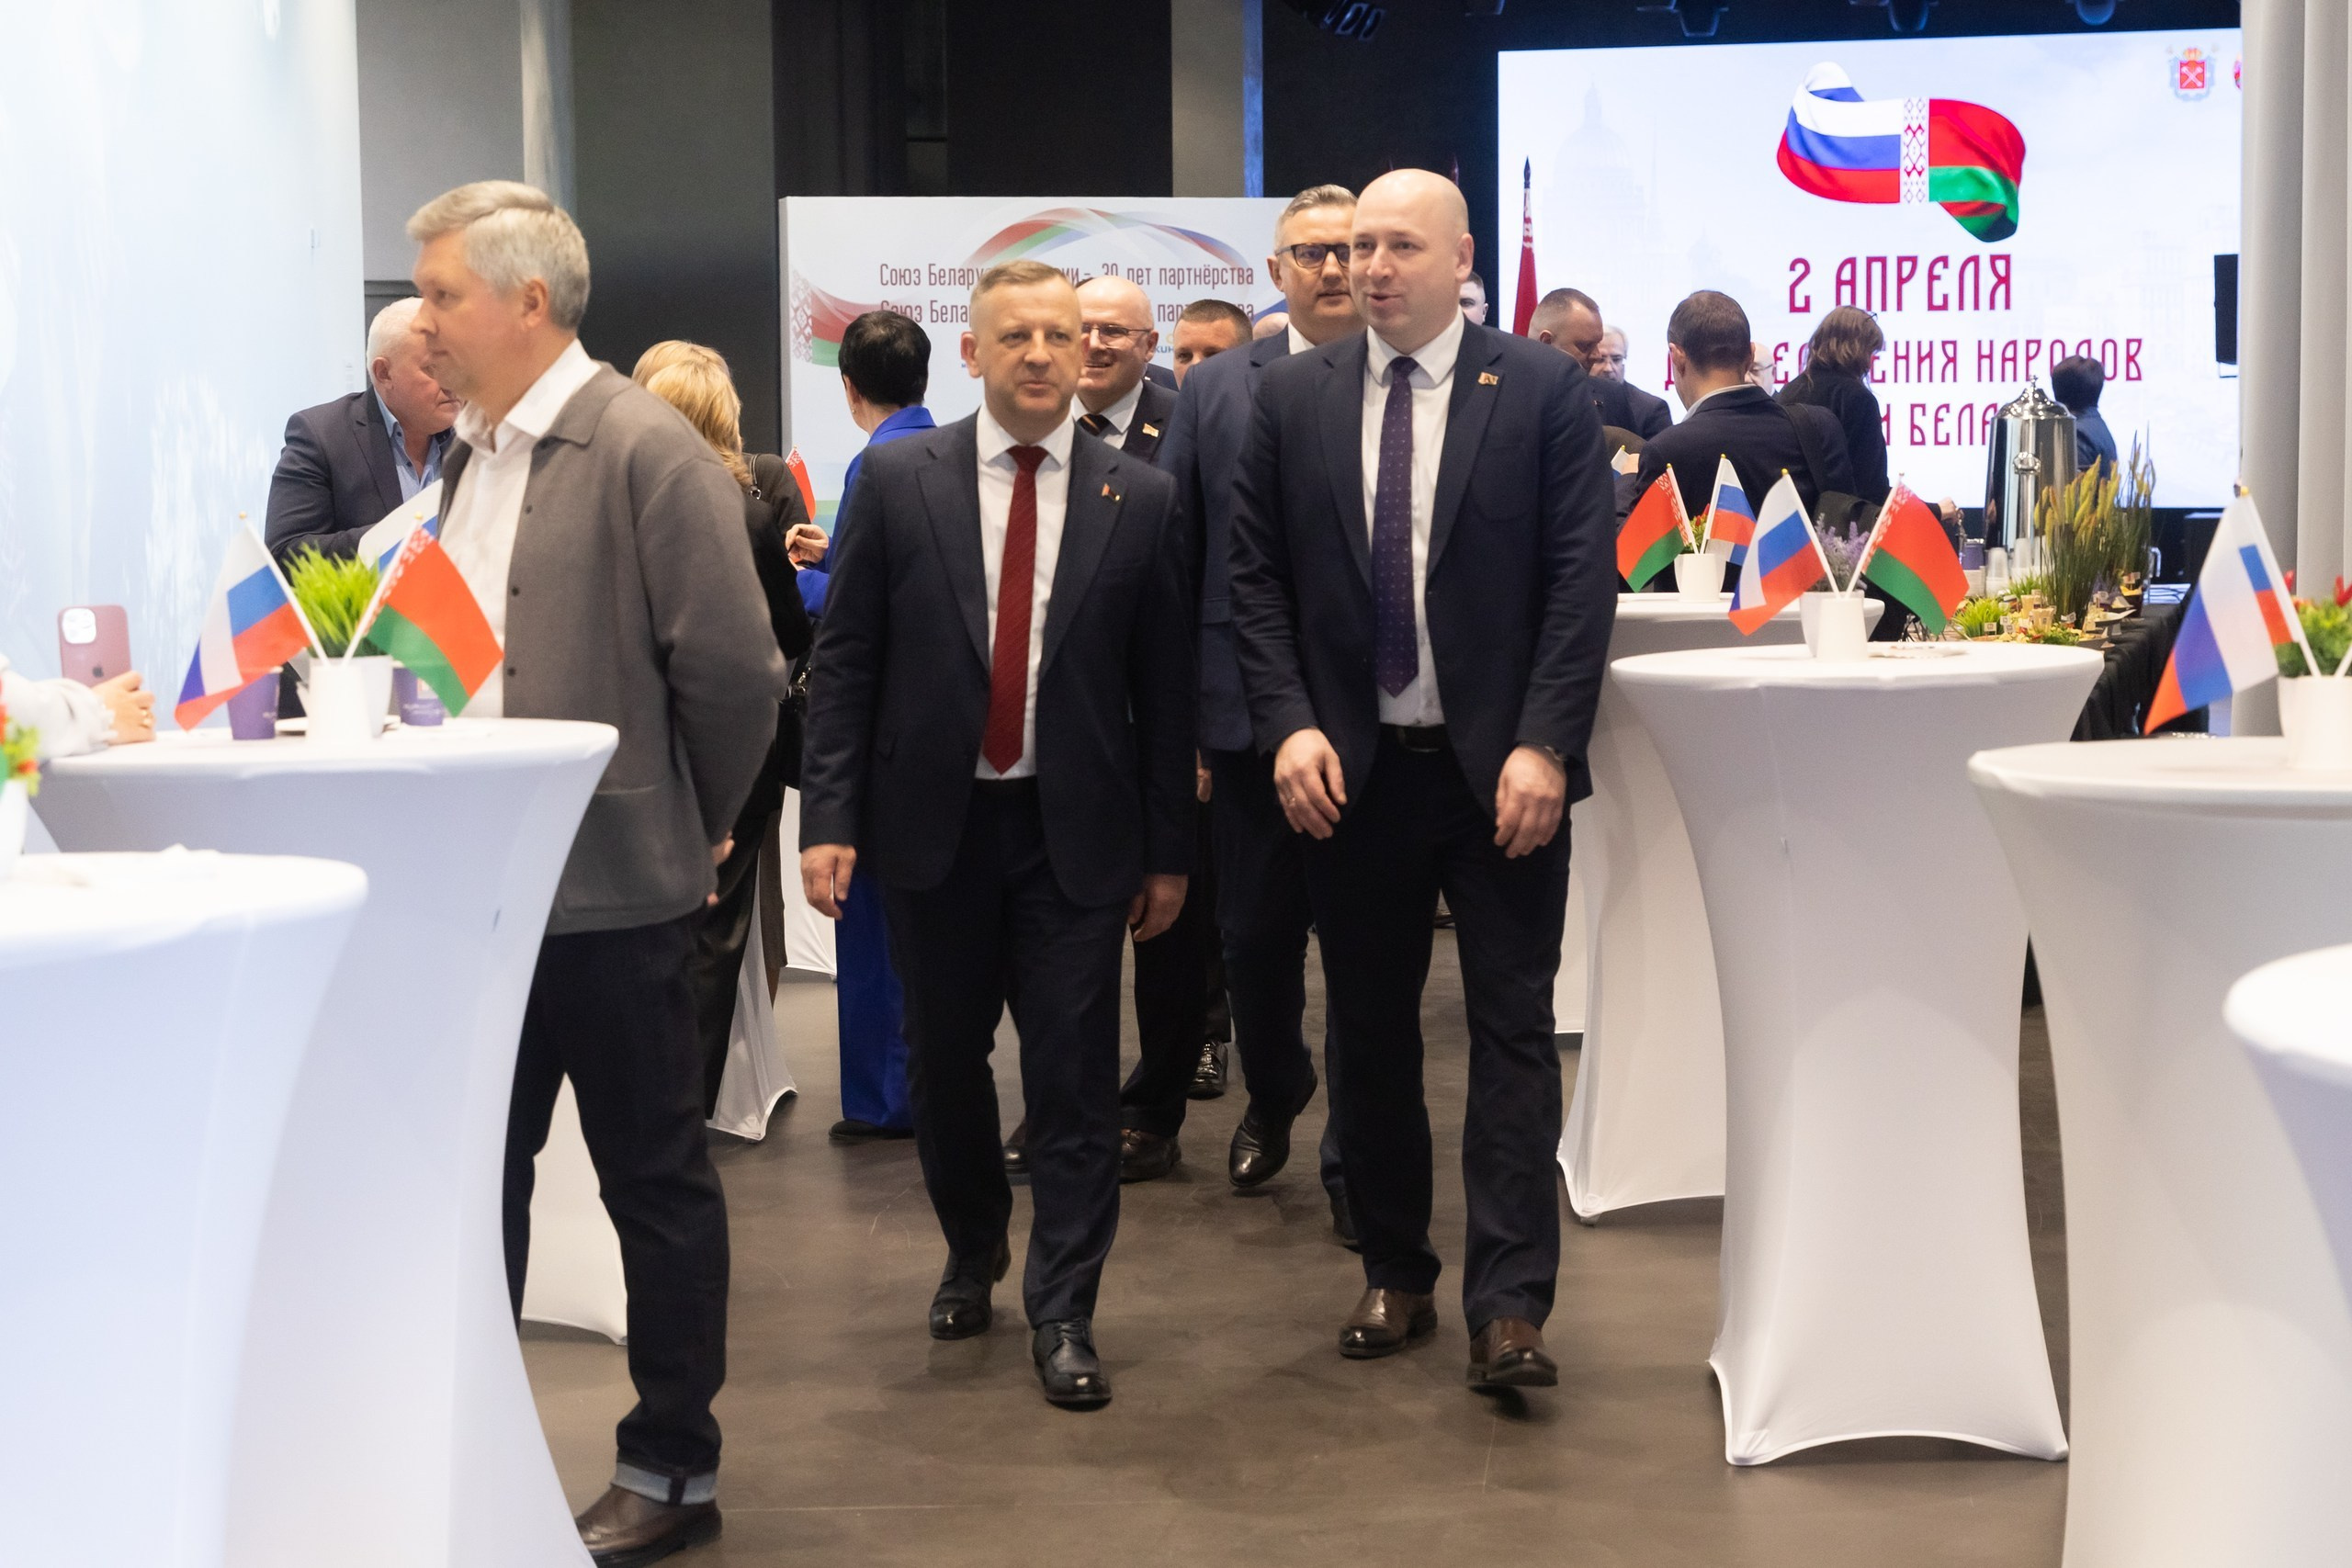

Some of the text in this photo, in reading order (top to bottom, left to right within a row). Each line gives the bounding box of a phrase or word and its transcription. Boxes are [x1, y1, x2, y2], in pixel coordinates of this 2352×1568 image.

[879, 263, 921, 287] Союз
[928, 263, 991, 291] Белару
[1159, 264, 1255, 290] партнёрства
[1789, 254, 2011, 313] 2 АПРЕЛЯ
